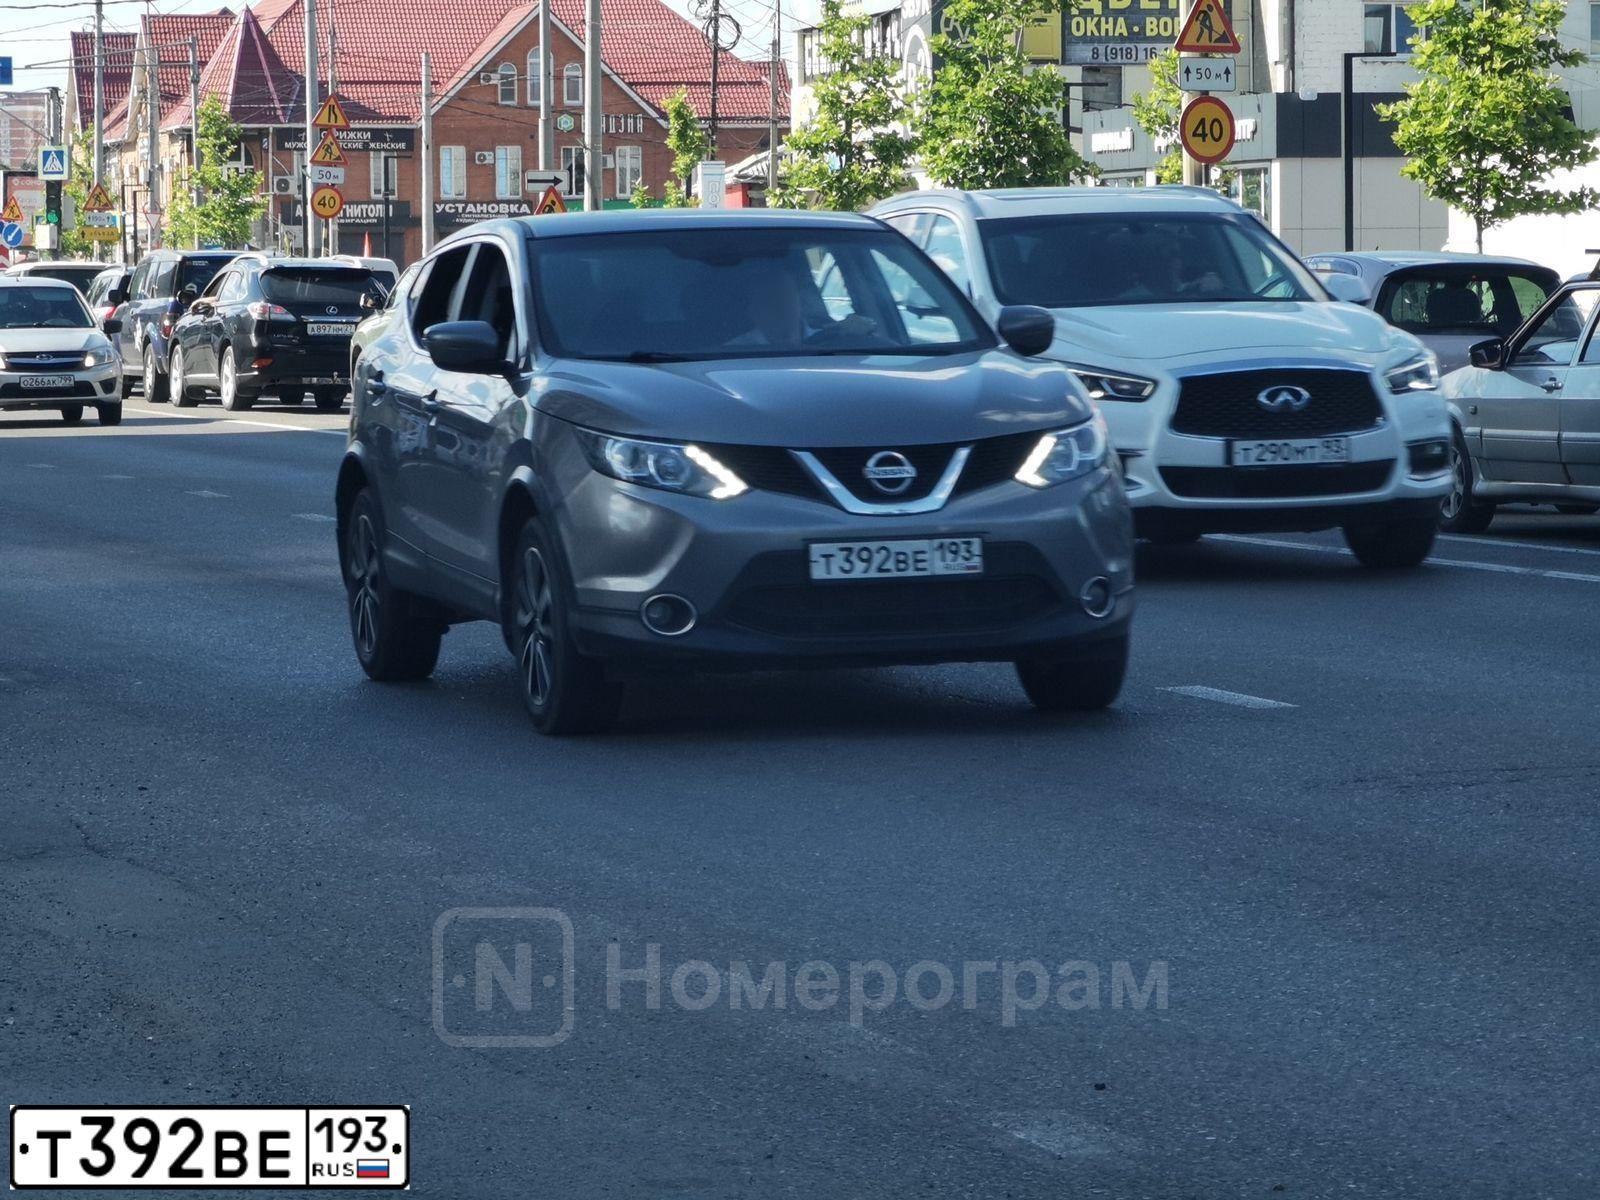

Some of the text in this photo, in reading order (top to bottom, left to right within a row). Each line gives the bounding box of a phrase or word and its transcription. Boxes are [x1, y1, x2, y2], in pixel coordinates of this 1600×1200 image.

[1071, 16, 1128, 37] ОКНА
[1091, 47, 1099, 60] 8
[1104, 45, 1139, 61] (918)
[1195, 67, 1212, 80] 50
[321, 131, 371, 140] СРИЖКИ
[1191, 117, 1224, 143] 40
[368, 142, 407, 150] ЖЕНСКИЕ
[317, 169, 332, 180] 50
[317, 195, 337, 209] 40
[434, 203, 531, 214] УСТАНОВКА
[819, 540, 974, 575] Т392ВЕ 193
